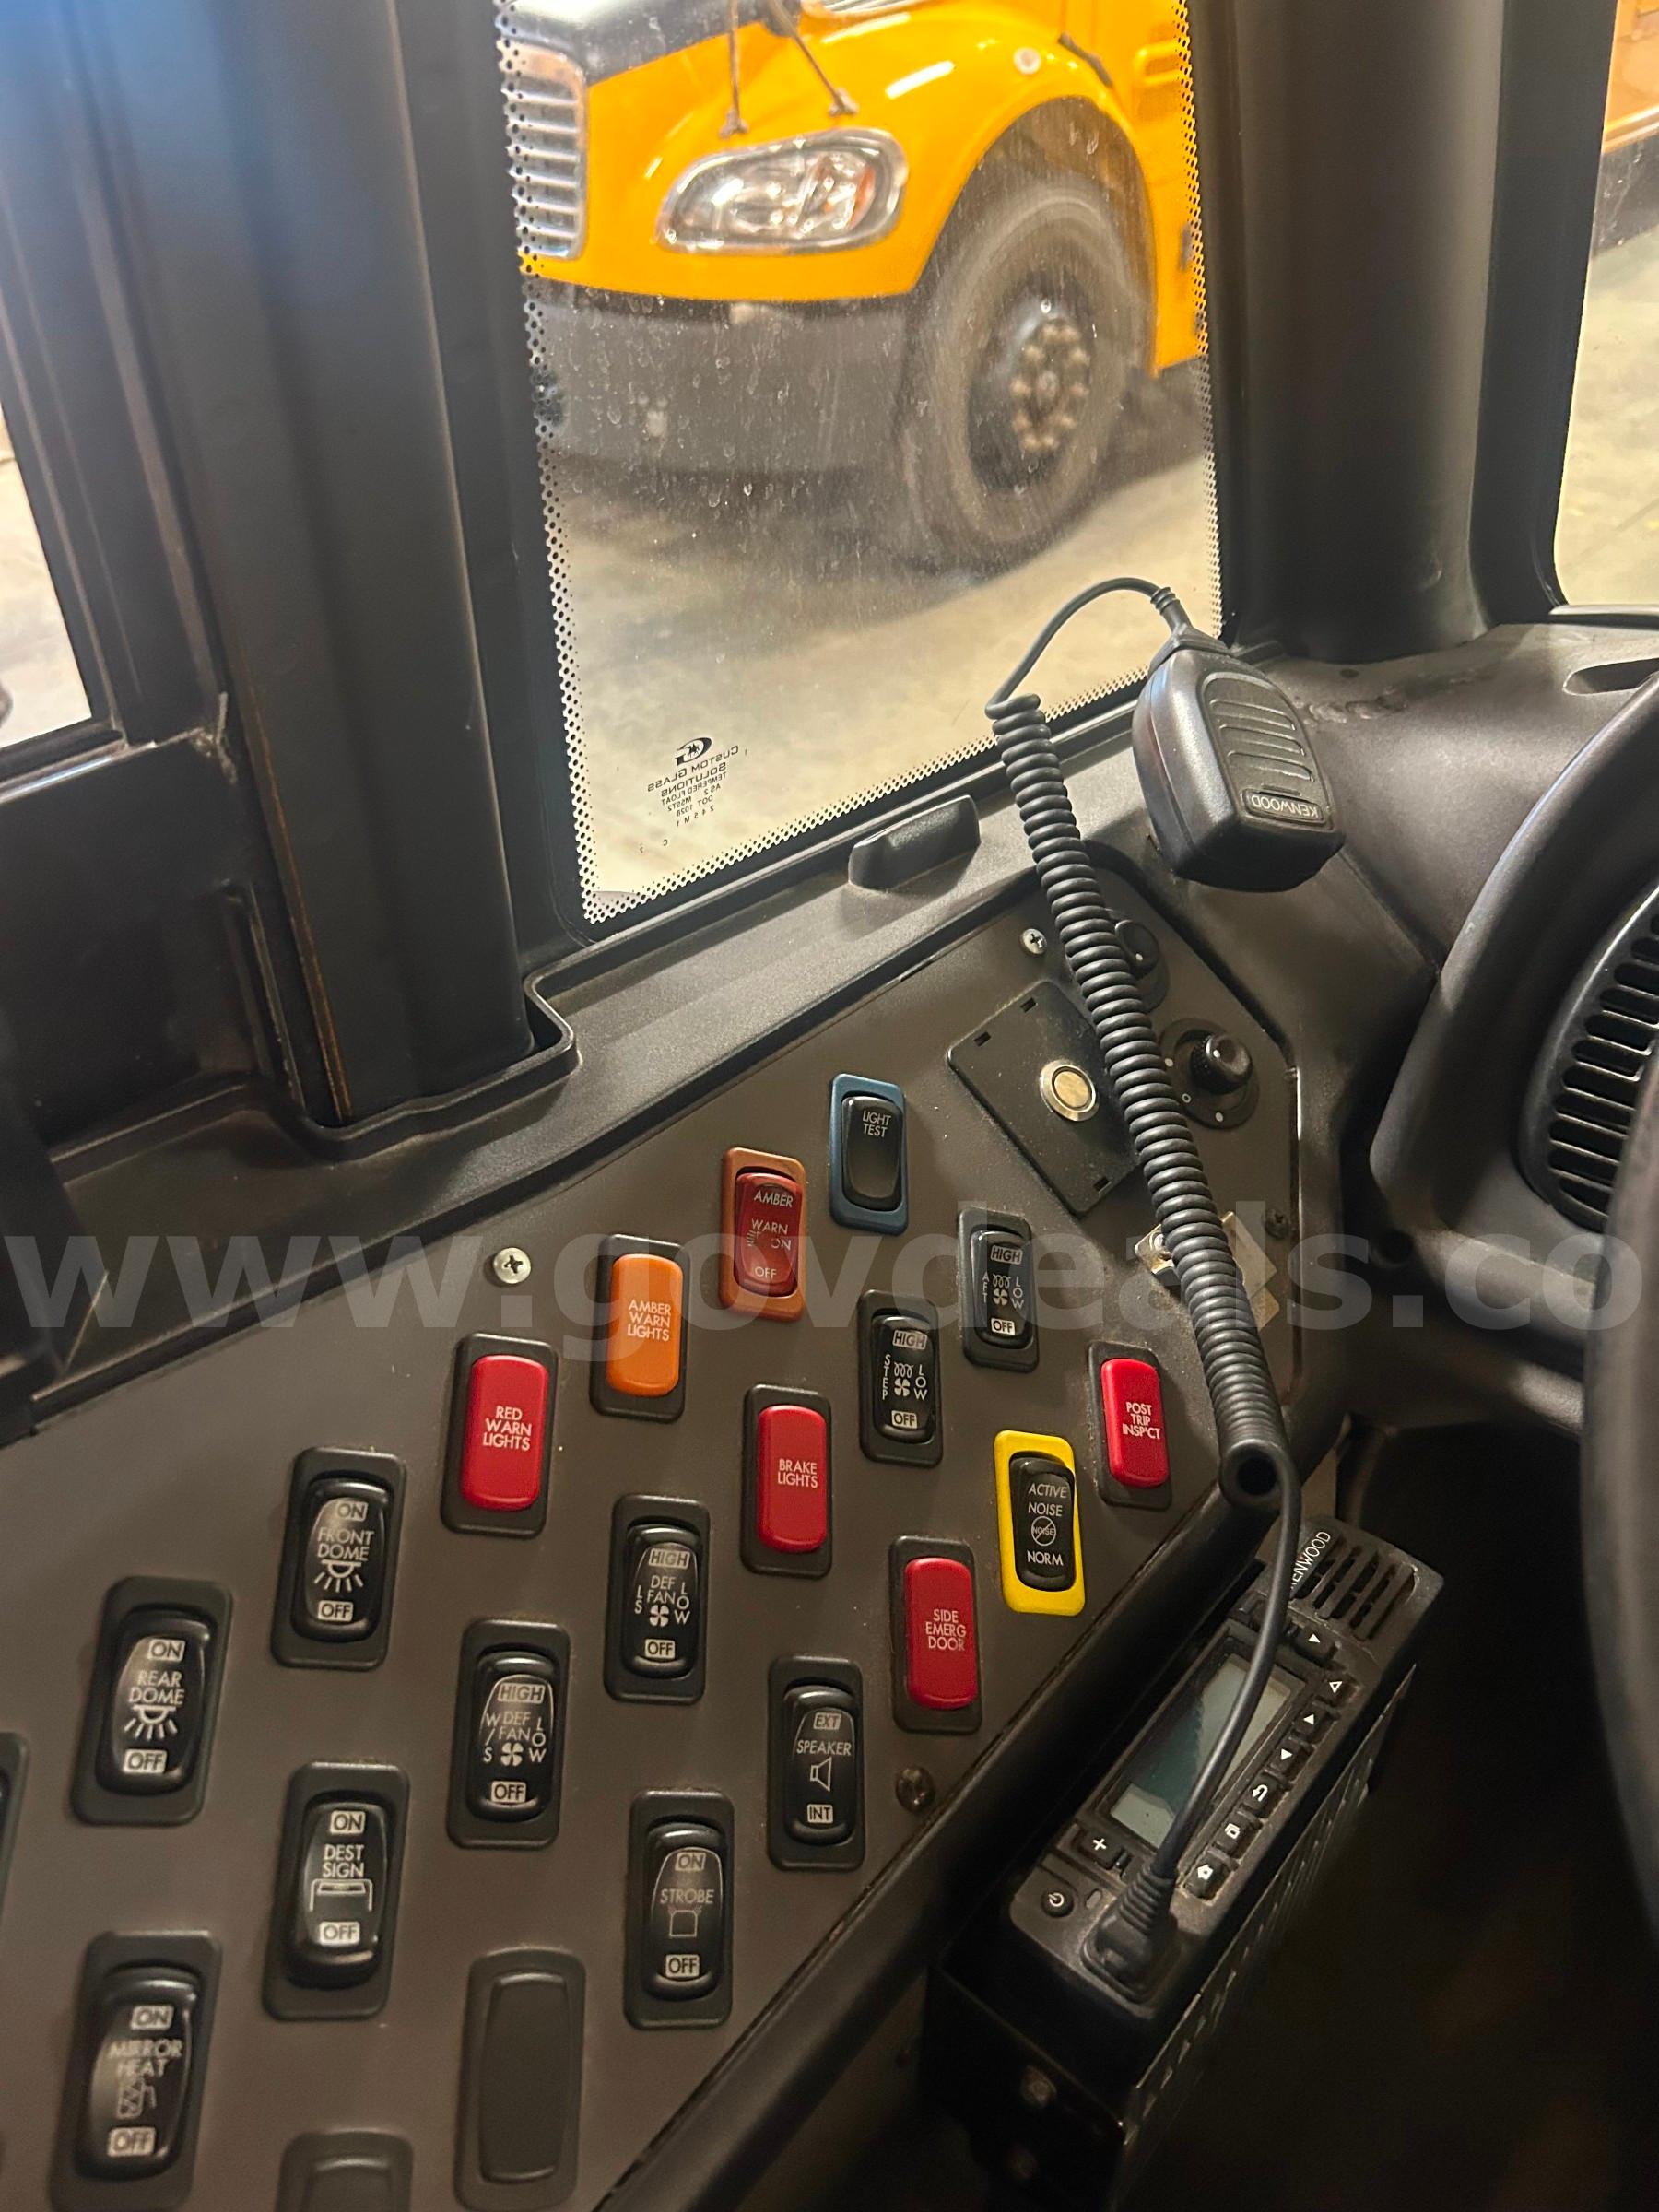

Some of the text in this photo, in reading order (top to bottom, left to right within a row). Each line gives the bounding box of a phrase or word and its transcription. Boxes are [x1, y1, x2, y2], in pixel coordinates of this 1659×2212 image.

[1251, 794, 1319, 818] KENWOOD
[863, 1110, 892, 1126] LIGHT
[863, 1123, 888, 1138] TEST
[754, 1189, 794, 1208] AMBER
[751, 1218, 789, 1235] WARN
[771, 1238, 792, 1251] ON
[992, 1247, 1022, 1263] HIGH
[755, 1265, 777, 1280] OFF
[1011, 1275, 1026, 1311] LOW
[628, 1300, 672, 1316] AMBER
[629, 1311, 671, 1328] WARN
[993, 1320, 1015, 1334] OFF
[627, 1324, 671, 1342] LIGHTS
[893, 1331, 926, 1349] HIGH
[913, 1363, 928, 1401] LOW
[495, 1405, 523, 1420] RED
[1125, 1401, 1152, 1416] POST
[485, 1418, 532, 1437] WARN
[893, 1412, 917, 1428] OFF
[1130, 1413, 1151, 1427] TRIP
[483, 1433, 531, 1452] LIGHTS
[779, 1458, 818, 1476] BRAKE
[777, 1471, 818, 1488] LIGHTS
[1028, 1482, 1068, 1499] ACTIVE
[337, 1502, 366, 1520] ON
[1028, 1501, 1064, 1518] NOISE
[318, 1526, 374, 1546] FRONT
[1032, 1526, 1055, 1536] NOISE
[317, 1543, 370, 1561] DOME
[651, 1549, 688, 1567] HIGH
[1027, 1550, 1064, 1567] NORM
[651, 1574, 677, 1590] DEF
[647, 1589, 676, 1605] FAN
[674, 1582, 691, 1625] LOW
[320, 1603, 351, 1619] OFF
[933, 1608, 959, 1624] SIDE
[925, 1621, 967, 1639] EMERG
[150, 1641, 182, 1658] ON
[647, 1641, 674, 1656] OFF
[927, 1636, 966, 1652] DOOR
[136, 1669, 182, 1688] REAR
[128, 1687, 184, 1705] DOME
[499, 1684, 544, 1702] HIGH
[503, 1711, 532, 1726] DEF
[815, 1713, 841, 1729] EXT
[498, 1725, 531, 1742] FAN
[527, 1716, 547, 1763] LOW
[796, 1739, 852, 1756] SPEAKER
[127, 1752, 164, 1771] OFF
[493, 1783, 524, 1801] OFF
[333, 1813, 363, 1831] ON
[808, 1806, 832, 1821] INT
[324, 1843, 365, 1862] DEST
[322, 1861, 365, 1878] SIGN
[677, 1853, 705, 1870] ON
[659, 1888, 715, 1905] STROBE
[323, 1924, 358, 1941] OFF
[667, 1956, 699, 1974] OFF
[135, 2007, 170, 2027] ON
[112, 2129, 154, 2153] OFF
